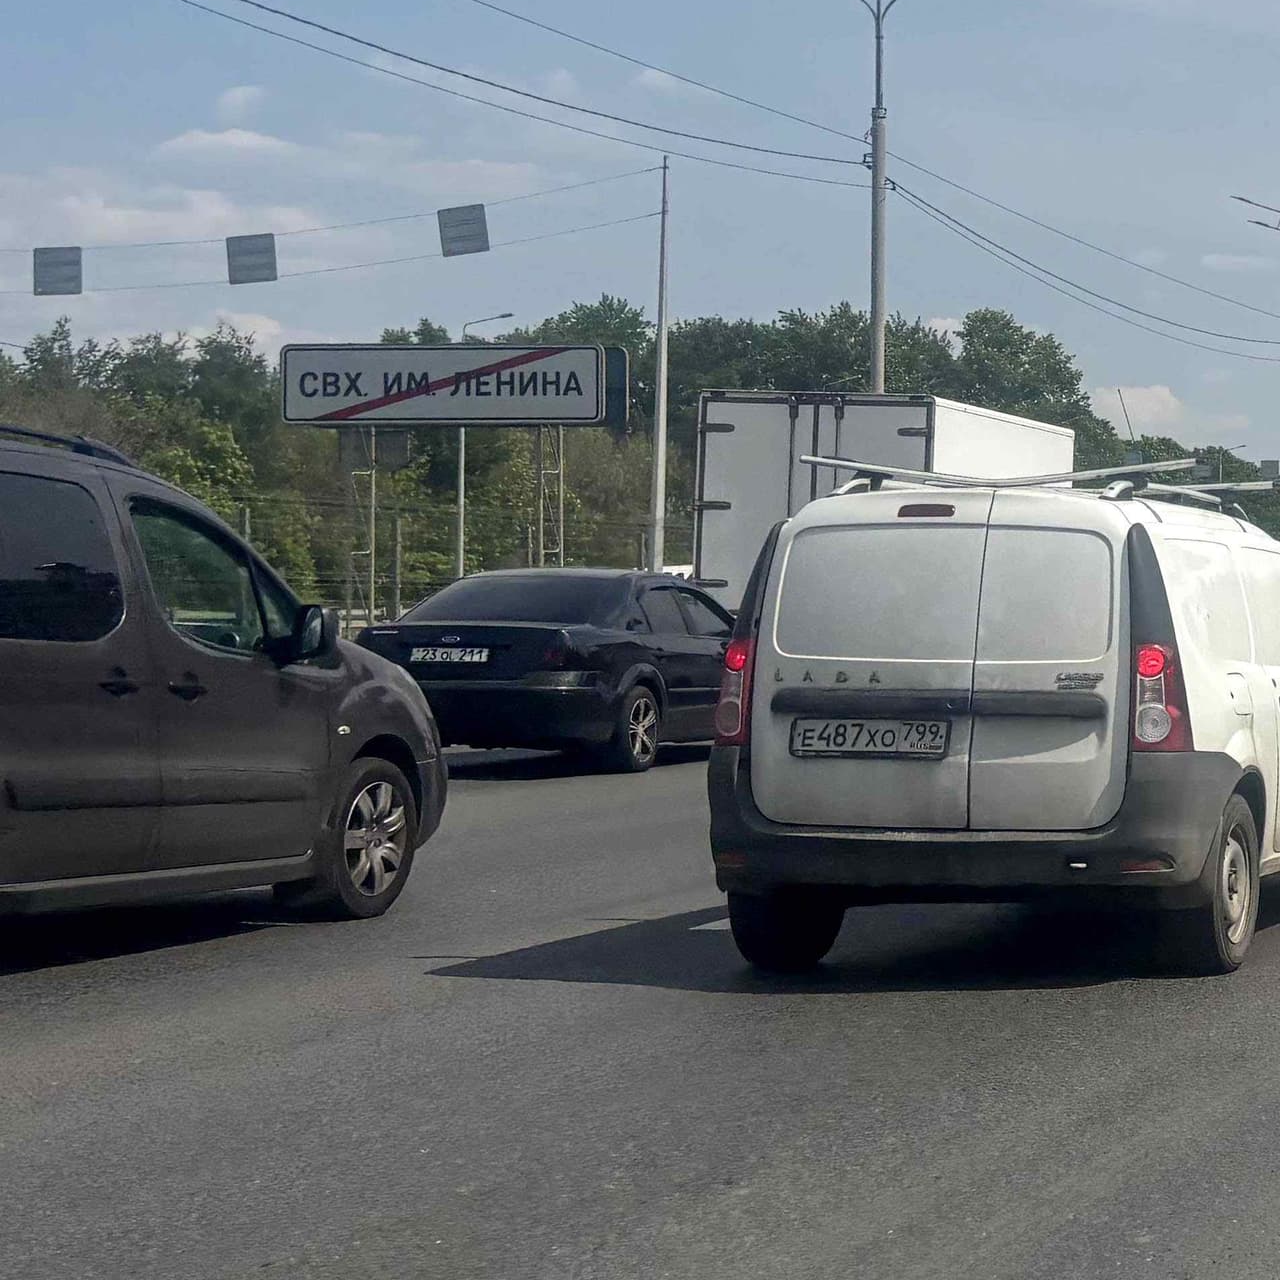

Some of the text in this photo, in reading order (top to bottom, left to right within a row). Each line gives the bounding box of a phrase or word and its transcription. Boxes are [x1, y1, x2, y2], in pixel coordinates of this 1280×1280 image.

[300, 371, 584, 398] СВХ. ИМ. ЛЕНИНА
[421, 648, 437, 661] 23
[459, 648, 484, 661] 211
[774, 668, 882, 683] LADA
[801, 723, 941, 748] Е487ХО 799
